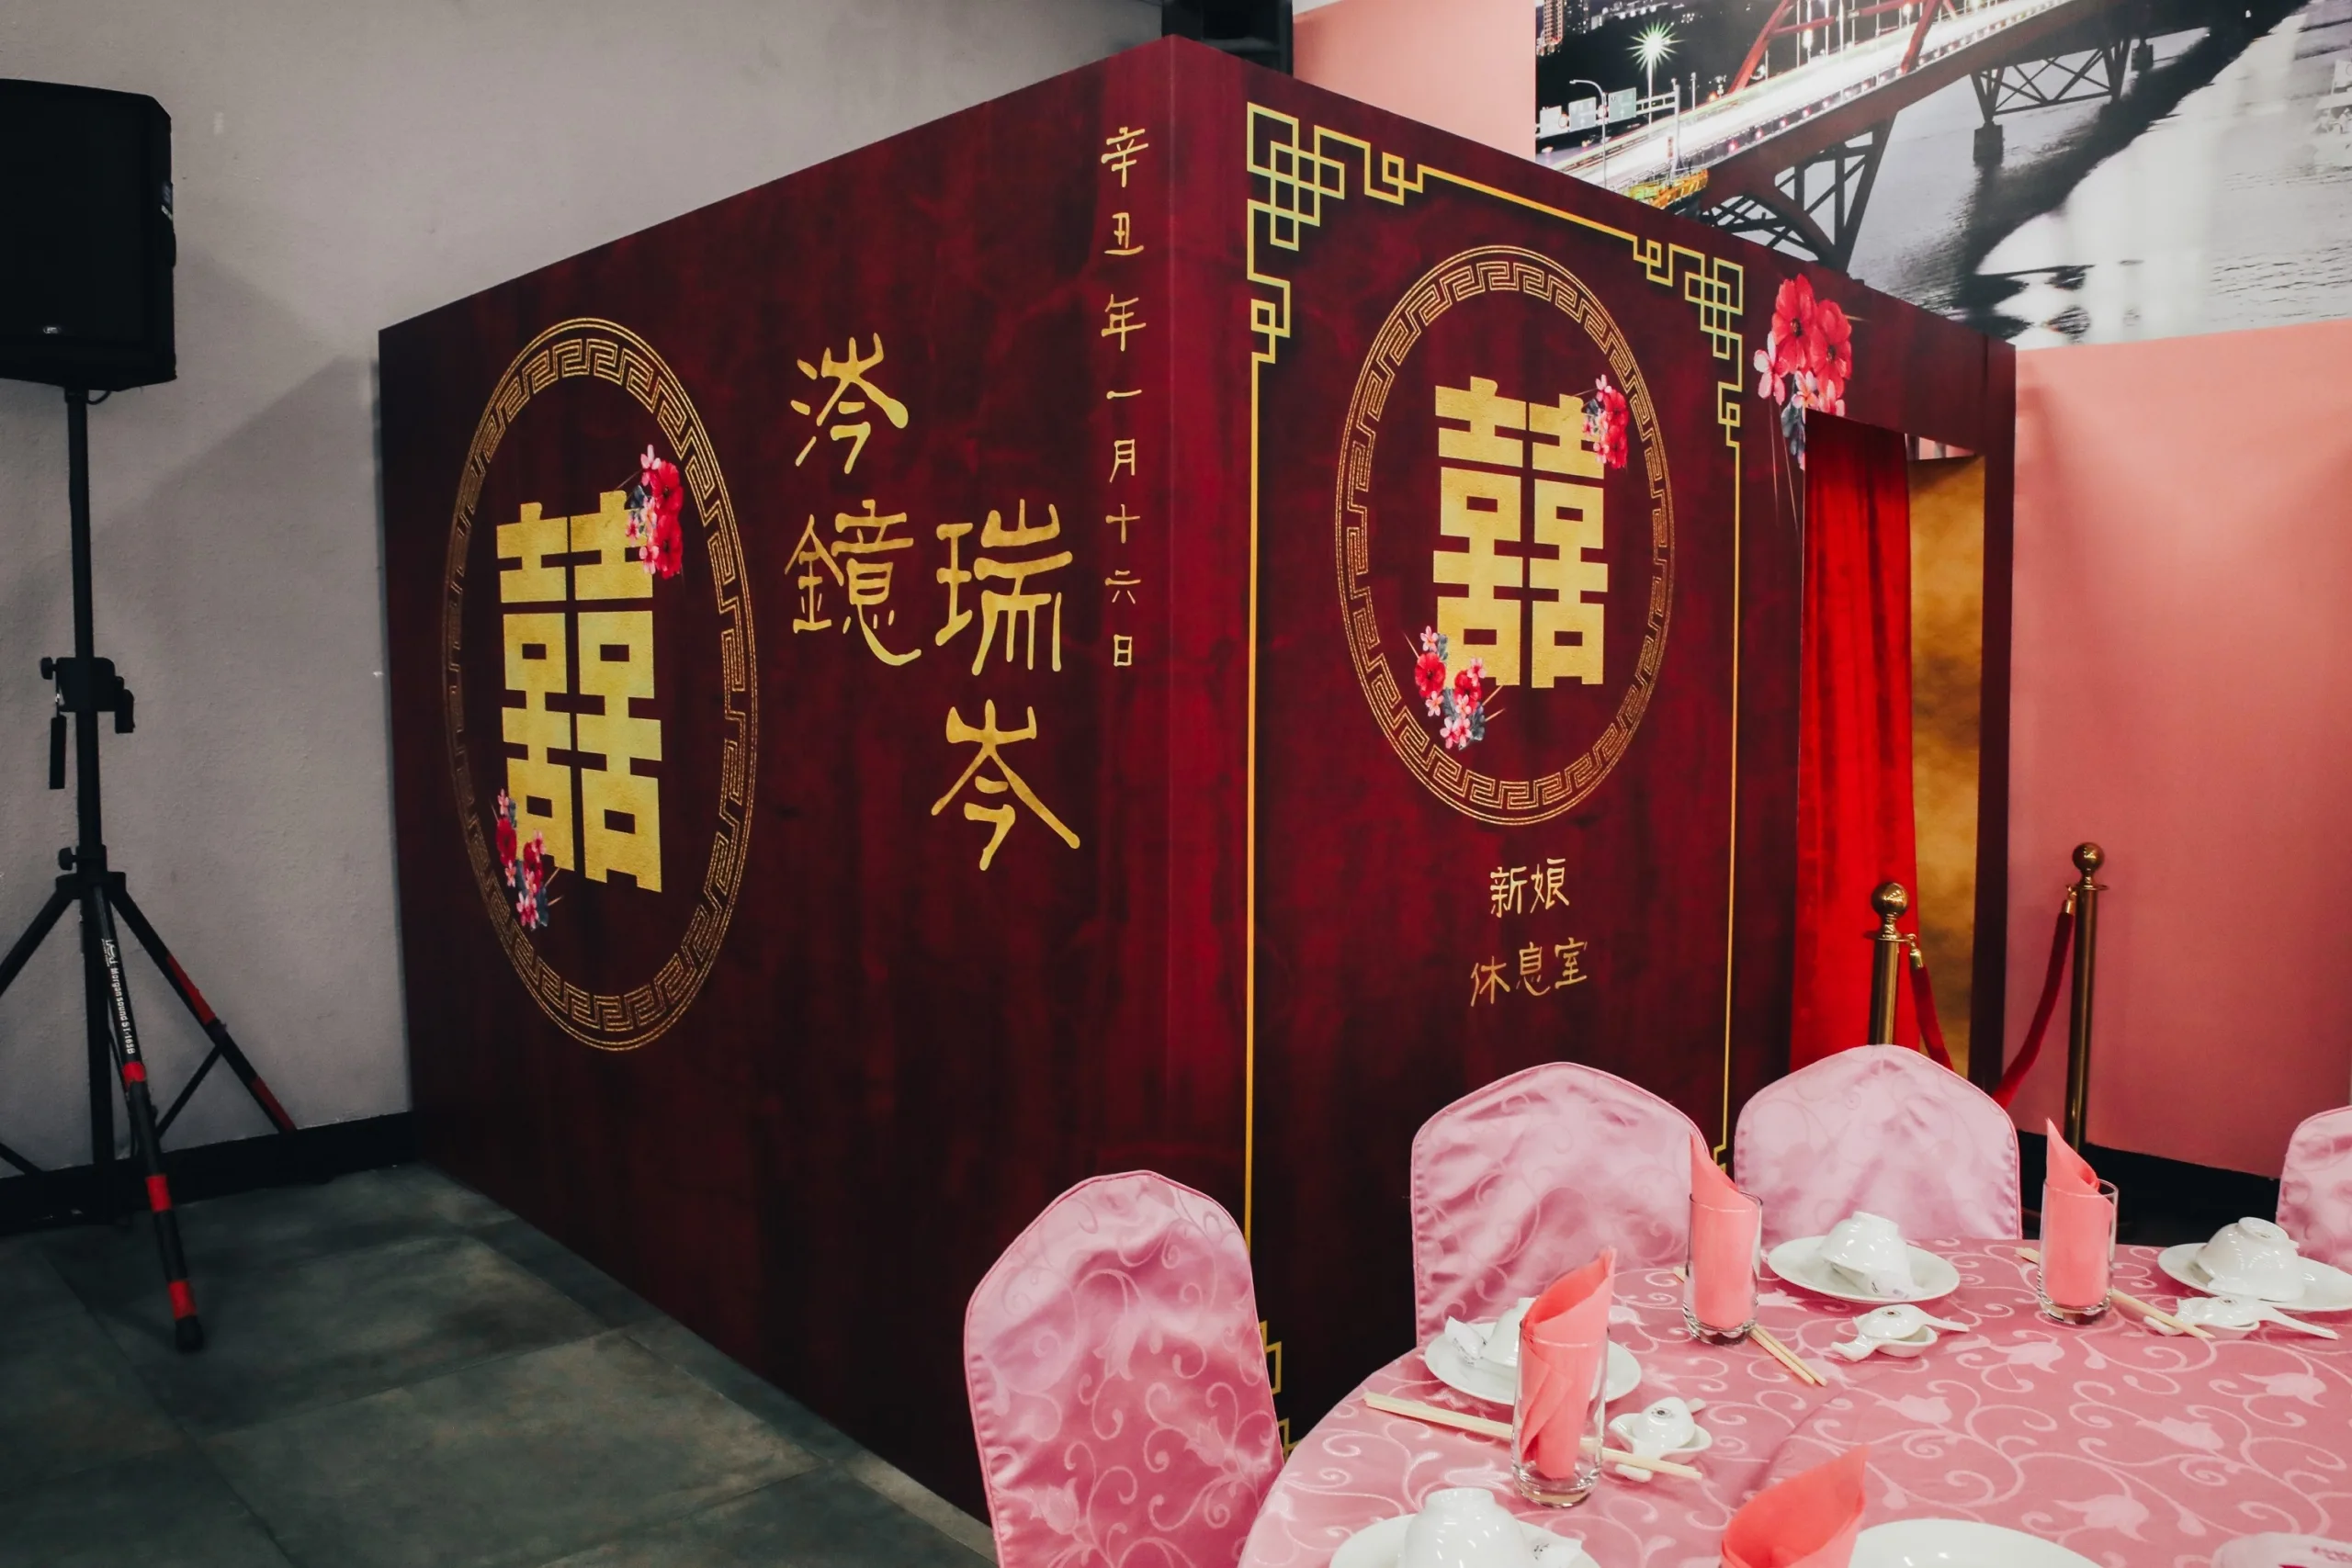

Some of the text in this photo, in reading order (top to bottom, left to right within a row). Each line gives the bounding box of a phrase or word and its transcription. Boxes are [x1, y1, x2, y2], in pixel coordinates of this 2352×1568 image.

[1101, 126, 1148, 667] 辛丑年一月十六日
[931, 498, 1080, 872] 瑞岑
[1470, 937, 1588, 1007] 休息室
[1489, 857, 1570, 919] 新娘
